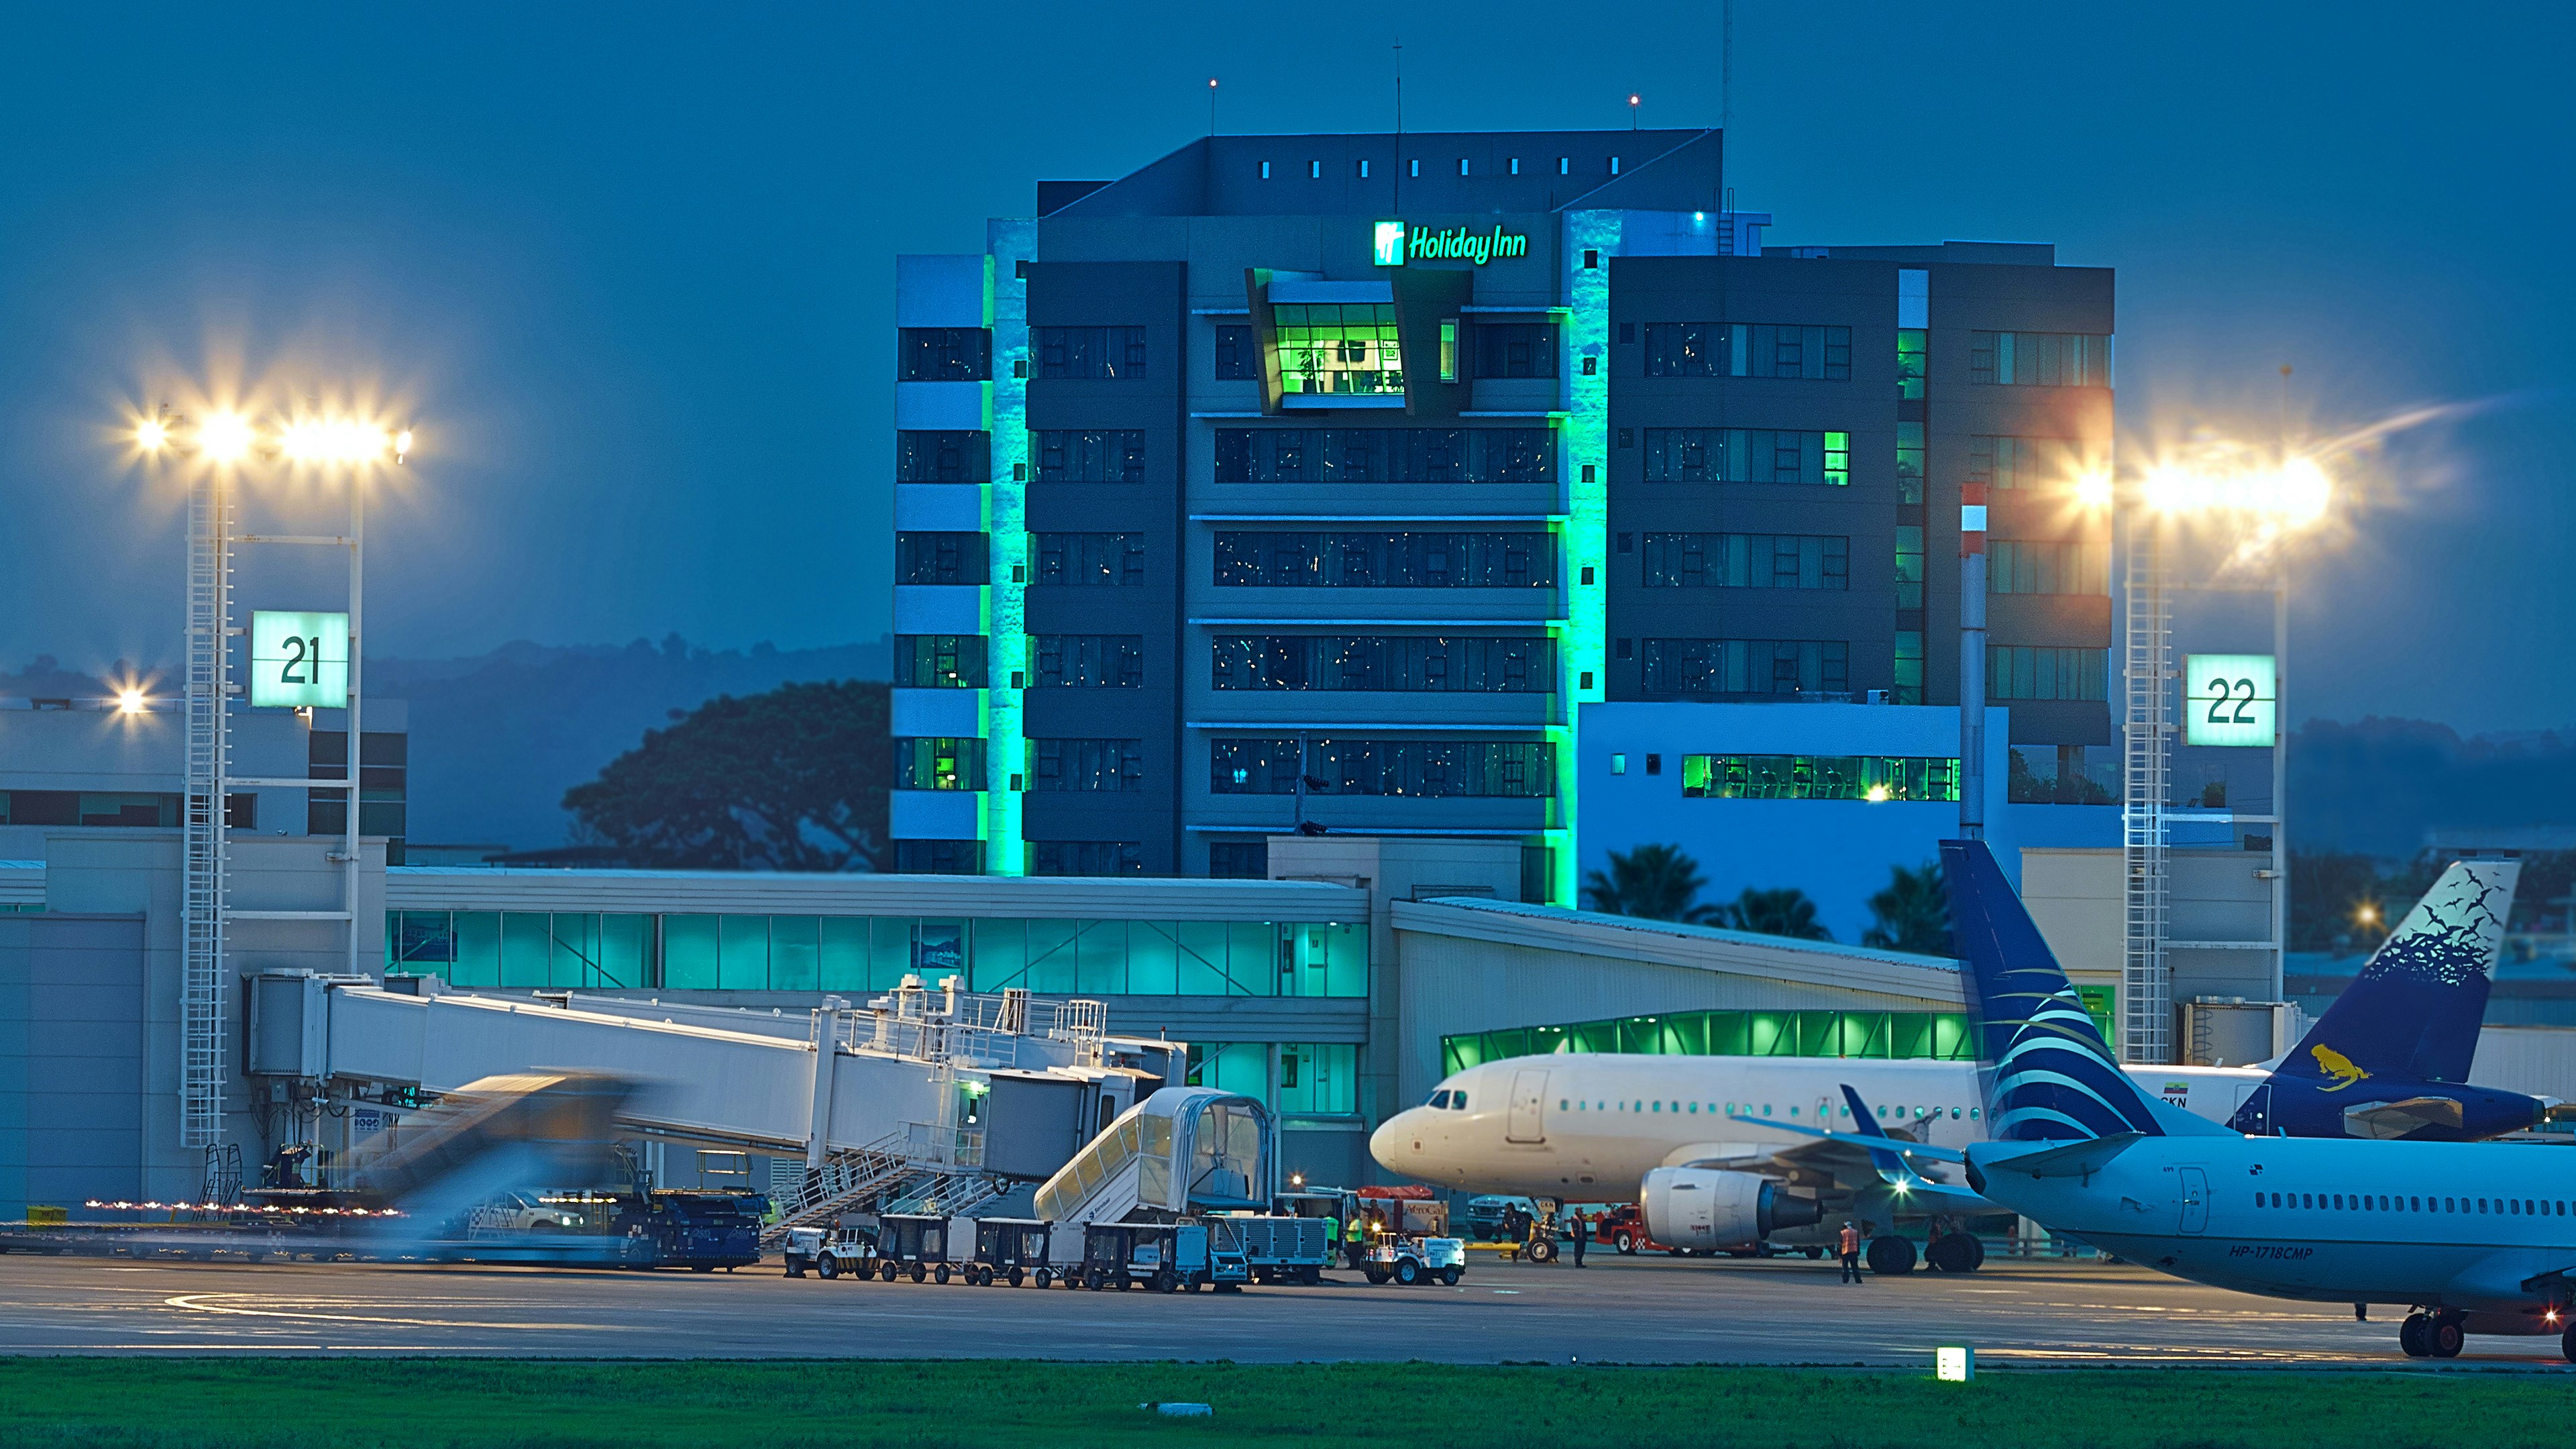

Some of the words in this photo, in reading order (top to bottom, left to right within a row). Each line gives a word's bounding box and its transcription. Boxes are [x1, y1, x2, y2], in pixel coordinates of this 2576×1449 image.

[1409, 227, 1491, 264] Holiday
[1492, 225, 1526, 257] Inn
[281, 636, 319, 684] 21
[2208, 678, 2255, 724] 22
[2229, 1245, 2314, 1260] HP-1718CMP
